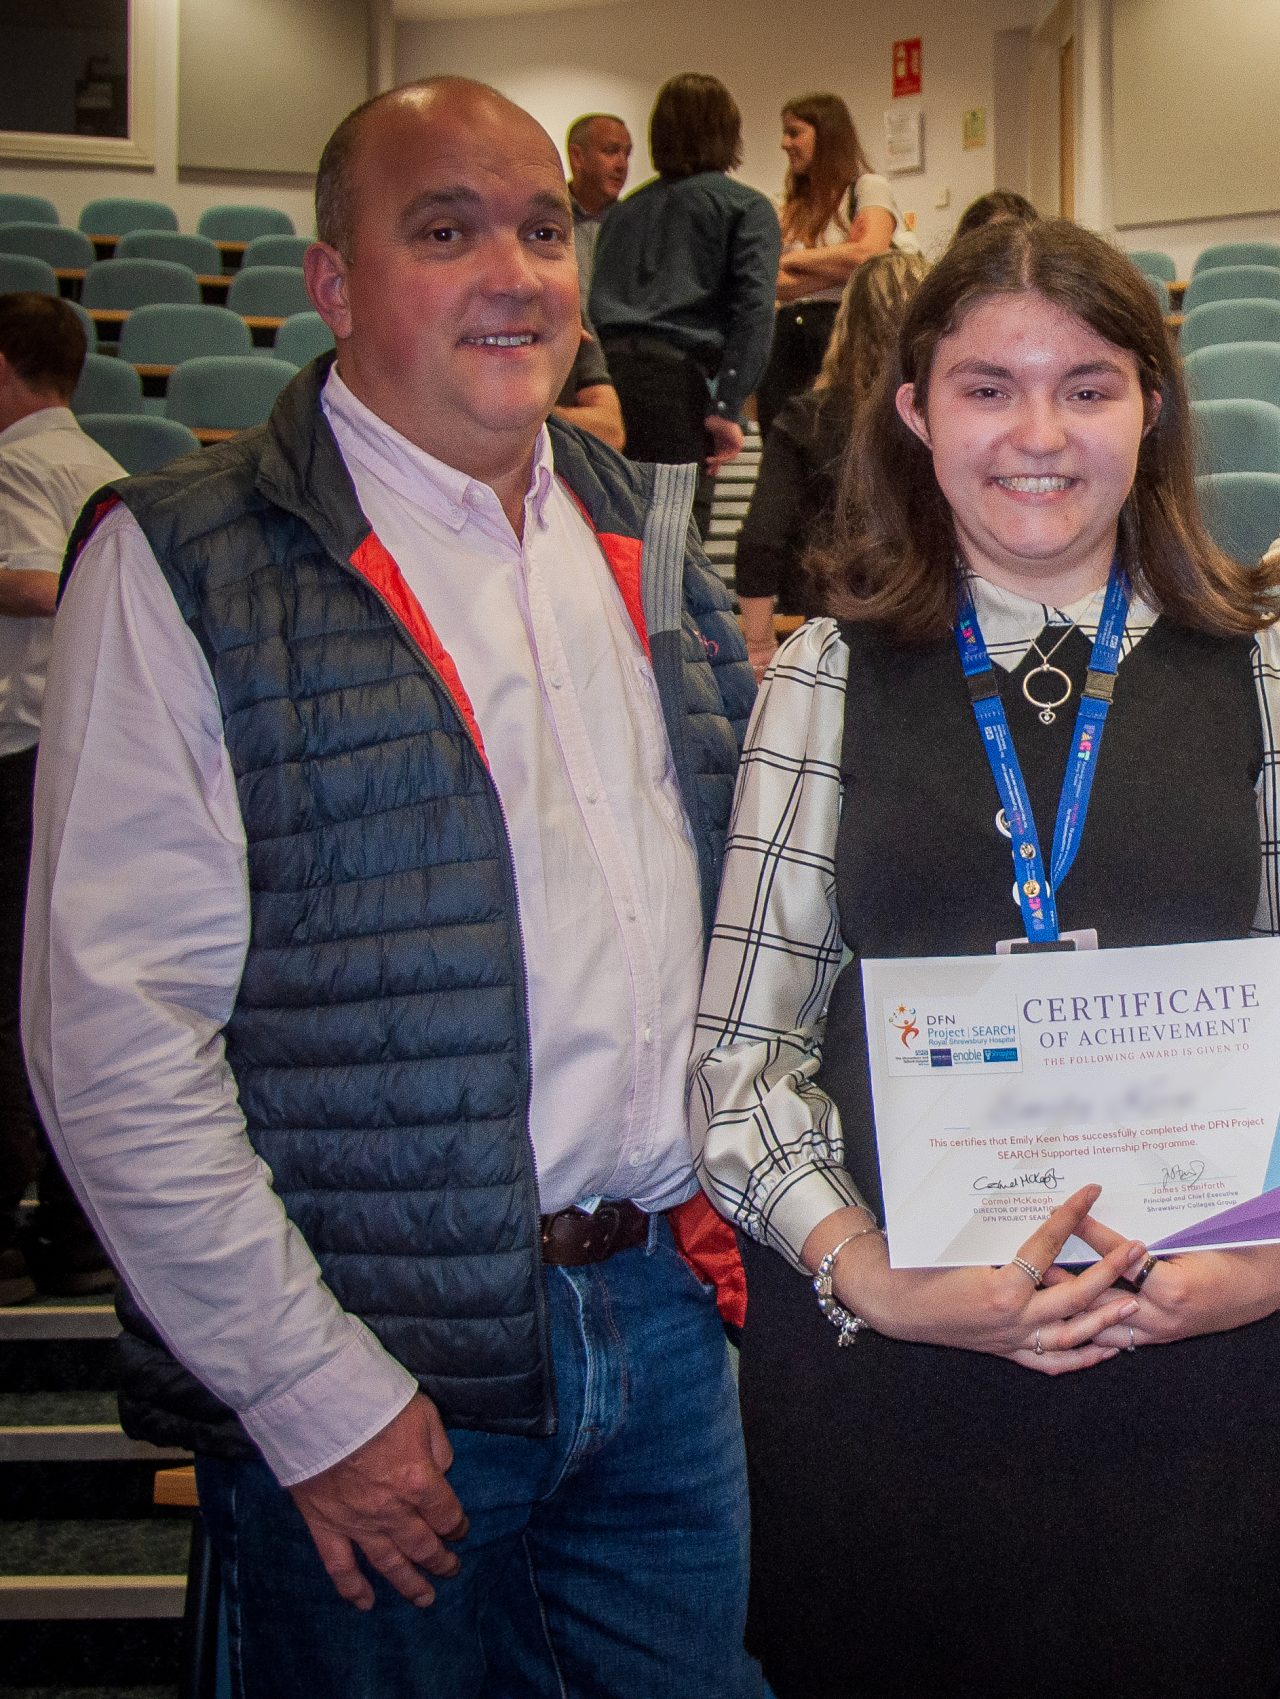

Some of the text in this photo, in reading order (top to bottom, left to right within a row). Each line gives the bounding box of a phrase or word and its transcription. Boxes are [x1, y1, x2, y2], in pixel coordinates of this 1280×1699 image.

[1077, 724, 1096, 761] PACT
[1028, 897, 1045, 930] PAC
[1023, 983, 1260, 1024] CERTIFICATE
[926, 1015, 955, 1025] DFN
[927, 1025, 1015, 1039] Project SEARCH
[988, 1036, 1015, 1045] Hospital
[1040, 1017, 1251, 1049] OF ACHIEVEMENT
[953, 1049, 982, 1061] enable
[1043, 1043, 1250, 1066] THE FOLLOWING AWARD IS GIVEN TO
[929, 1118, 1264, 1148] This certifies that Emily Keen has successfully completed the DFN Project
[997, 1139, 1198, 1160] SEARCH Supported Internship Programme.
[1152, 1181, 1225, 1195] James Staniforth
[1013, 1196, 1053, 1205] McKeogh
